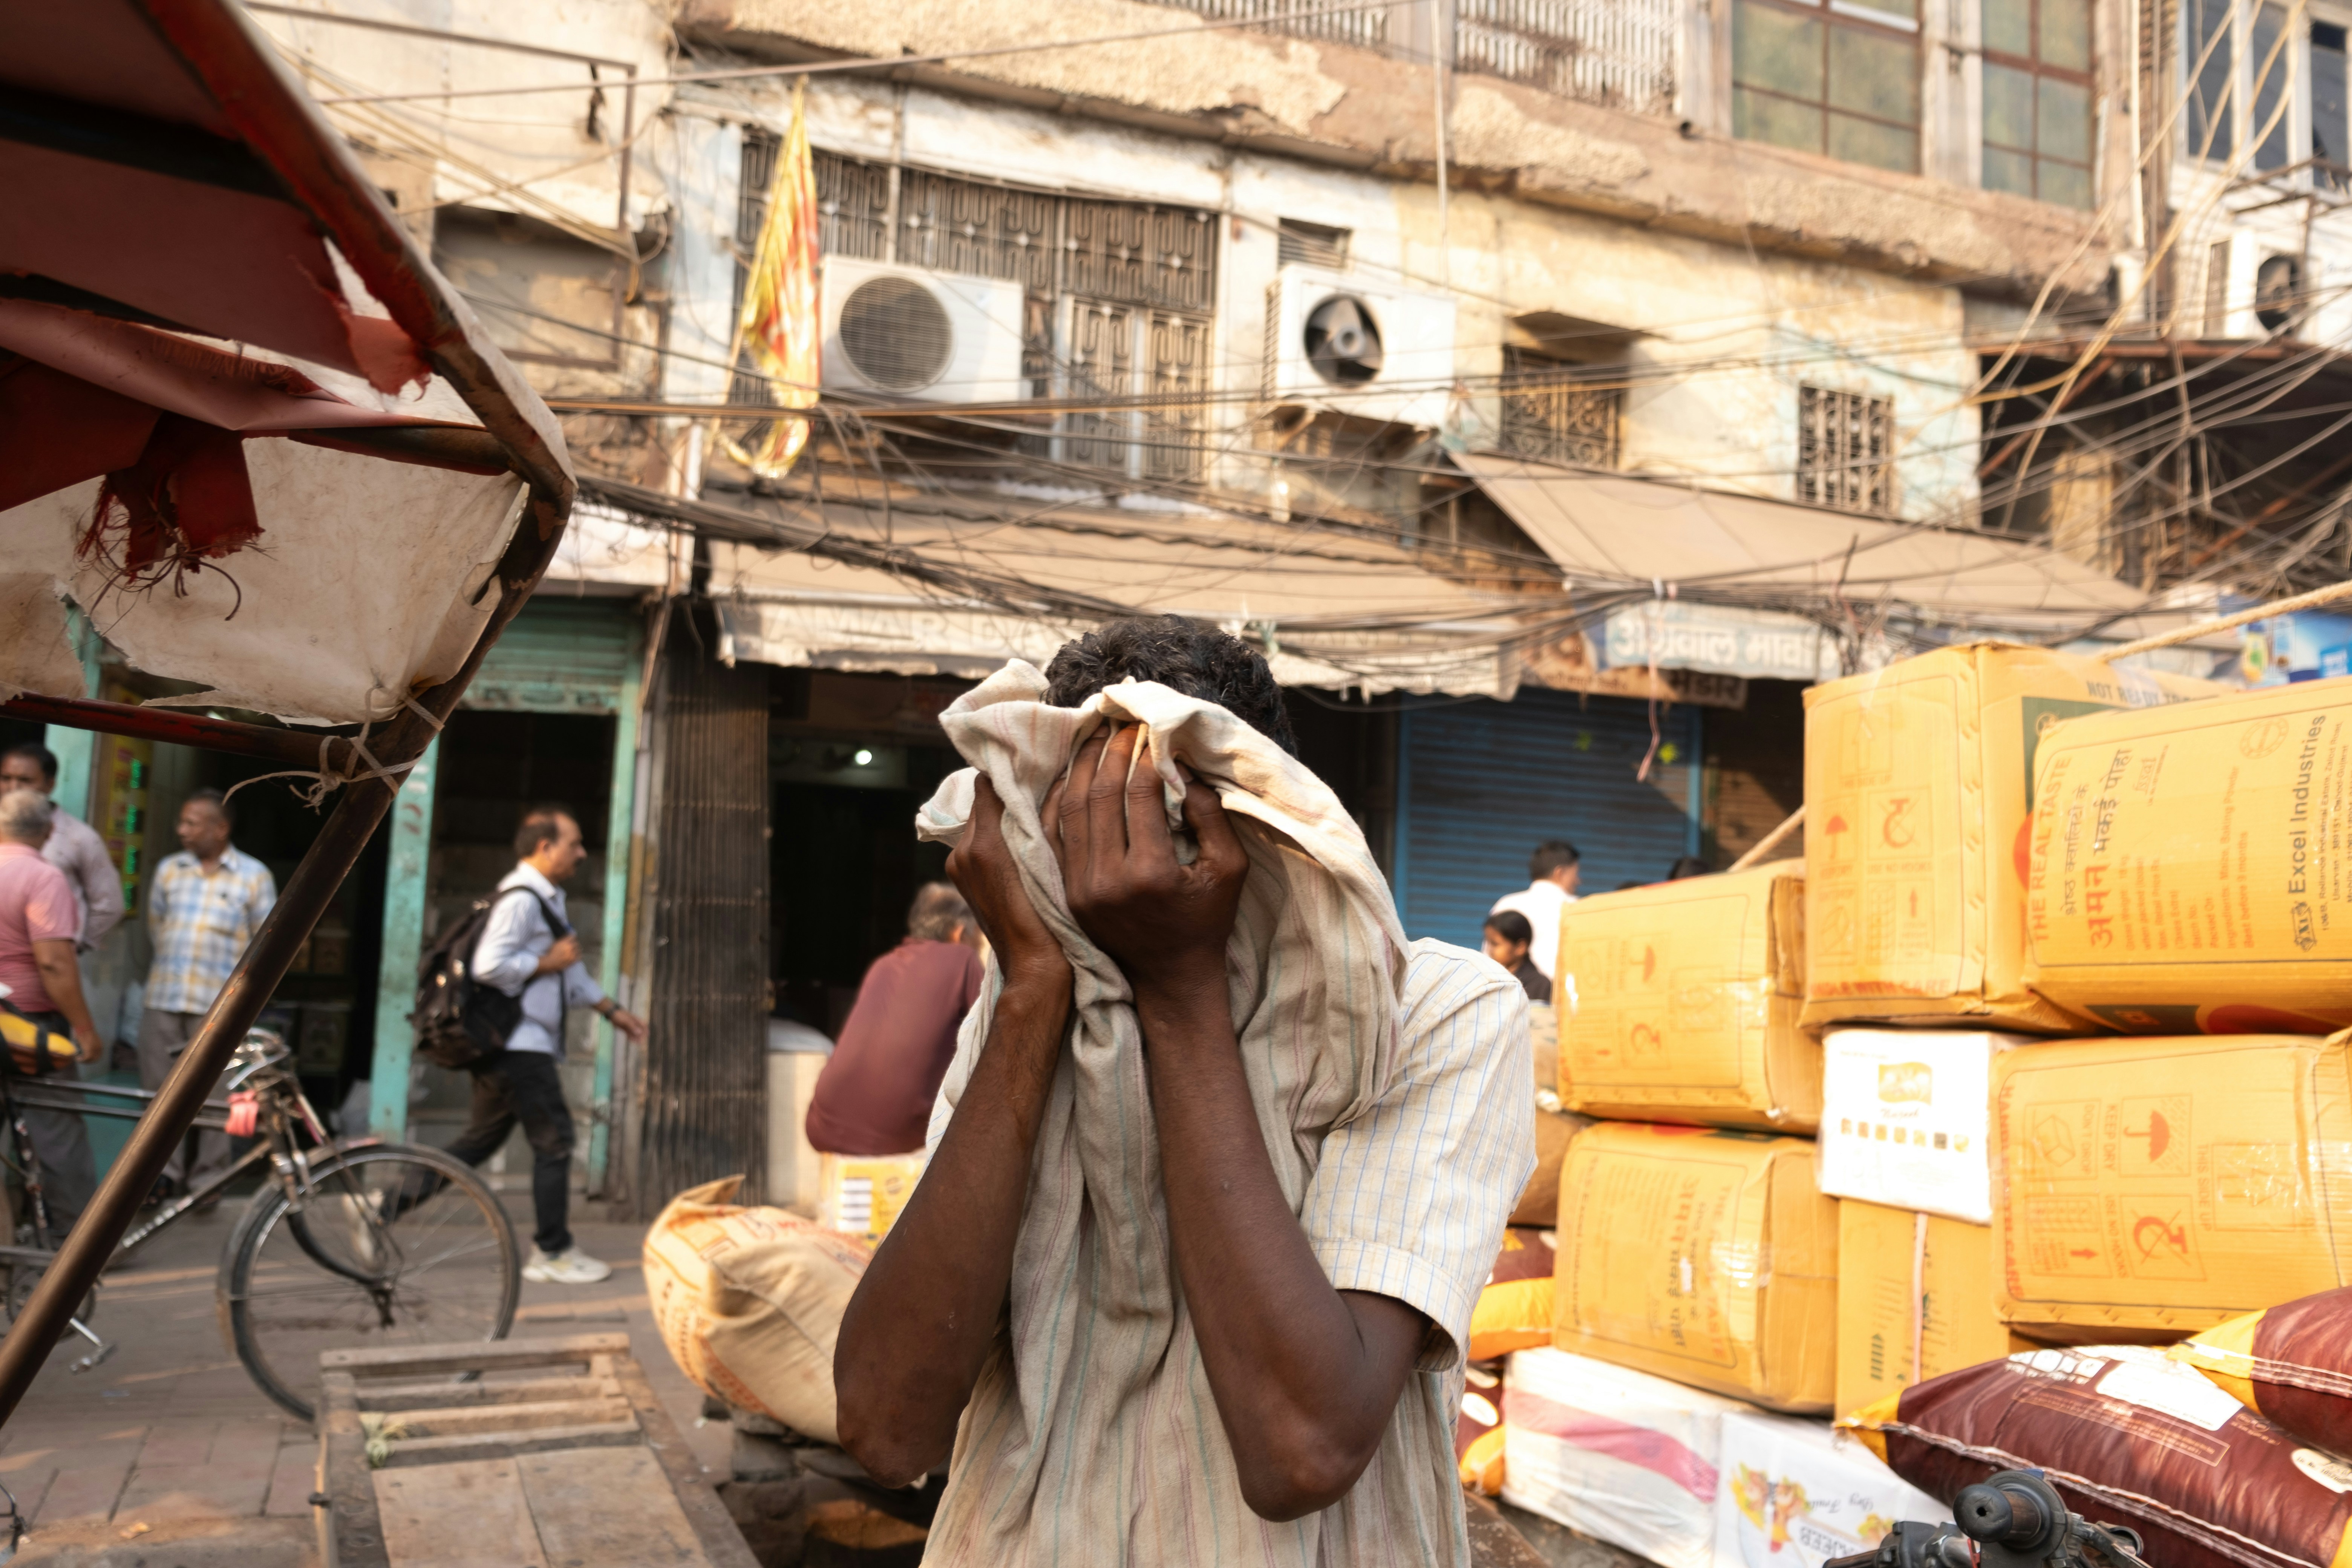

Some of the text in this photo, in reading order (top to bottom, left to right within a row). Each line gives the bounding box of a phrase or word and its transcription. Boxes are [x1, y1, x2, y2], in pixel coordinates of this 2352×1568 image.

[2086, 680, 2112, 699] NOT
[2072, 784, 2089, 801] के
[2288, 714, 2327, 823] Industries
[2030, 757, 2072, 942] THE REAL TASTE
[2085, 748, 2133, 949] अमन मकई पोहा
[2287, 830, 2307, 894] Excel
[2080, 1142, 2093, 1175] DROP
[2104, 1104, 2119, 1171] KEEP DRY
[2197, 1144, 2212, 1232] THIS SIDE UP
[2104, 1195, 2128, 1279] USE NO HOOKS
